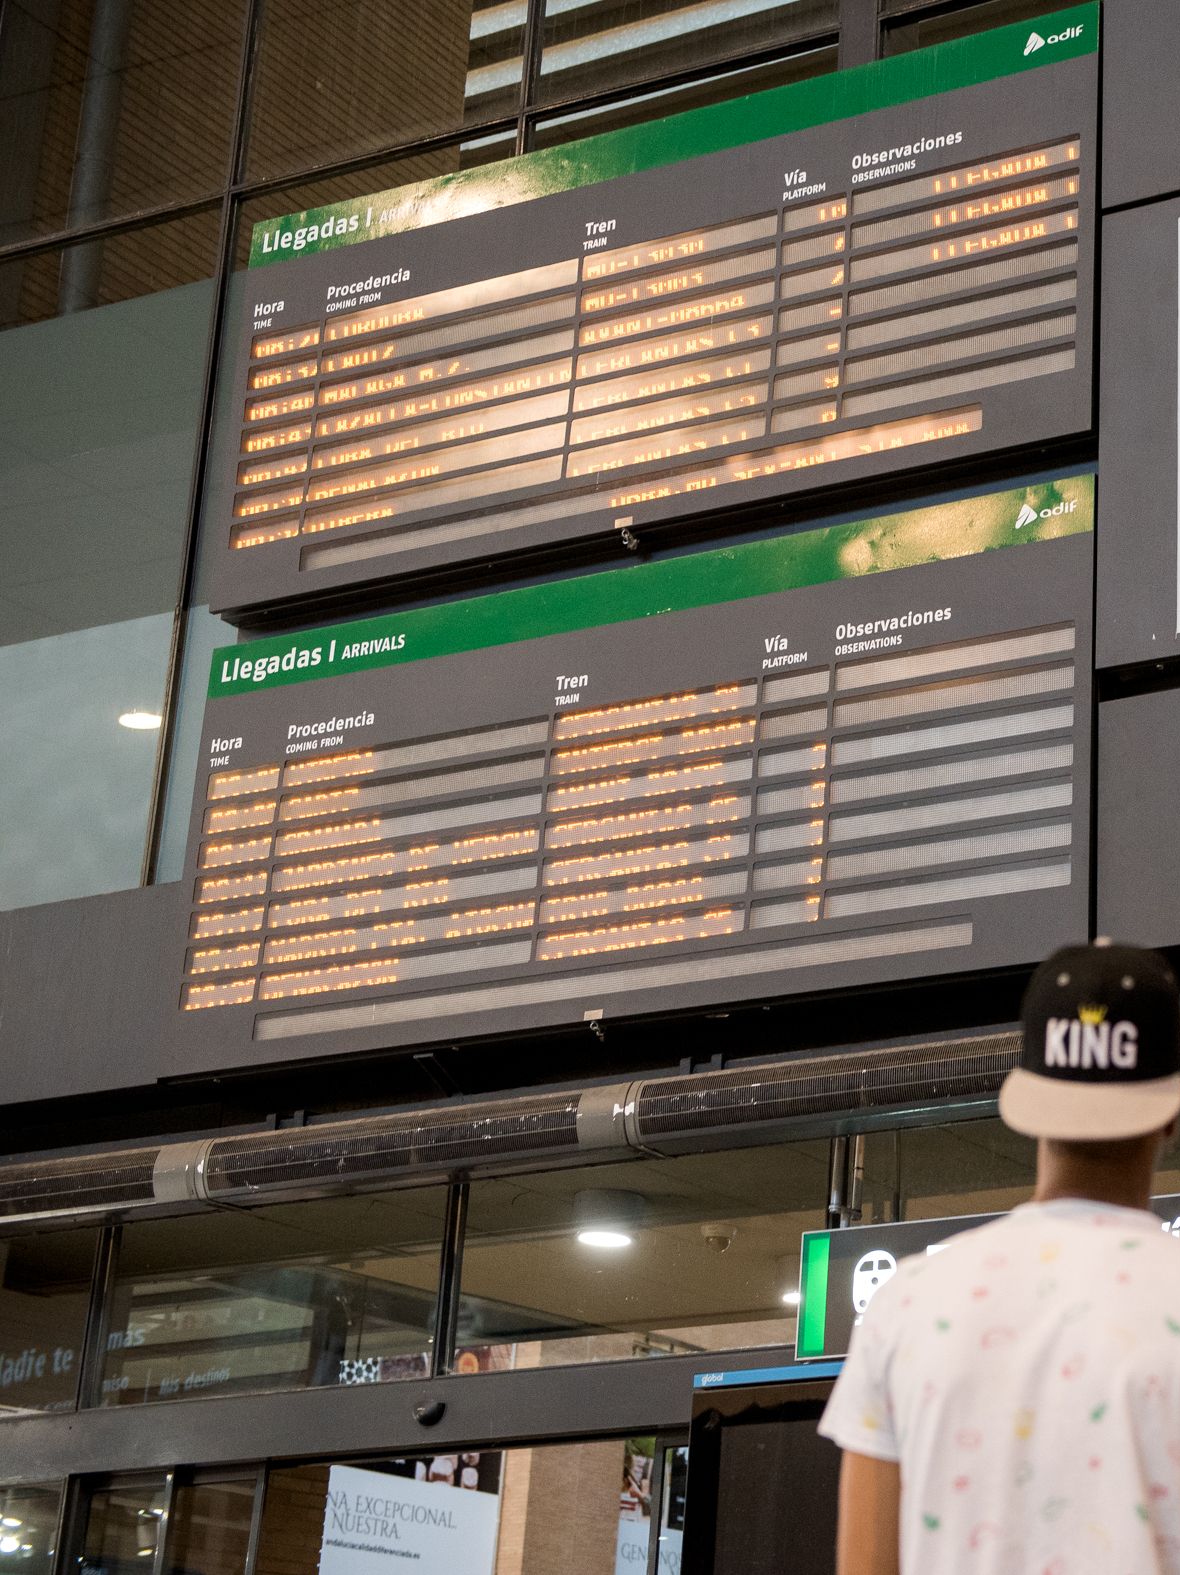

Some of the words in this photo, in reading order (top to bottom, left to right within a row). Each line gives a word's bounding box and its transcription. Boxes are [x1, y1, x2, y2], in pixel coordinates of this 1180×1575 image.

[1047, 23, 1085, 44] adif
[851, 130, 963, 170] Observaciones
[784, 168, 807, 187] Vía
[851, 159, 917, 184] OBSERVATIONS
[782, 182, 826, 201] PLATFORM
[262, 214, 359, 254] Llegadas
[585, 217, 617, 237] Tren
[582, 237, 608, 251] TRAIN
[327, 268, 411, 300] Procedencia
[253, 300, 285, 318] Hora
[326, 297, 357, 313] COMING
[359, 292, 382, 306] FROM
[253, 318, 272, 331] TIME
[1040, 499, 1079, 520] adif
[835, 606, 953, 641] Observaciones
[764, 635, 788, 654] Vía
[834, 634, 903, 657] OBSERVATIONS
[221, 645, 322, 683] Llegadas
[341, 634, 406, 660] ARRIVALS
[762, 651, 808, 670] PLATFORM
[556, 672, 589, 692] Tren
[554, 693, 580, 707] TRAIN
[287, 711, 376, 740] Procedencia
[211, 735, 243, 753] Hora
[286, 738, 318, 754] COMING
[320, 735, 344, 748] FROM
[209, 755, 230, 768] TIME
[1045, 1017, 1139, 1070] KING
[0, 1347, 47, 1388] adie
